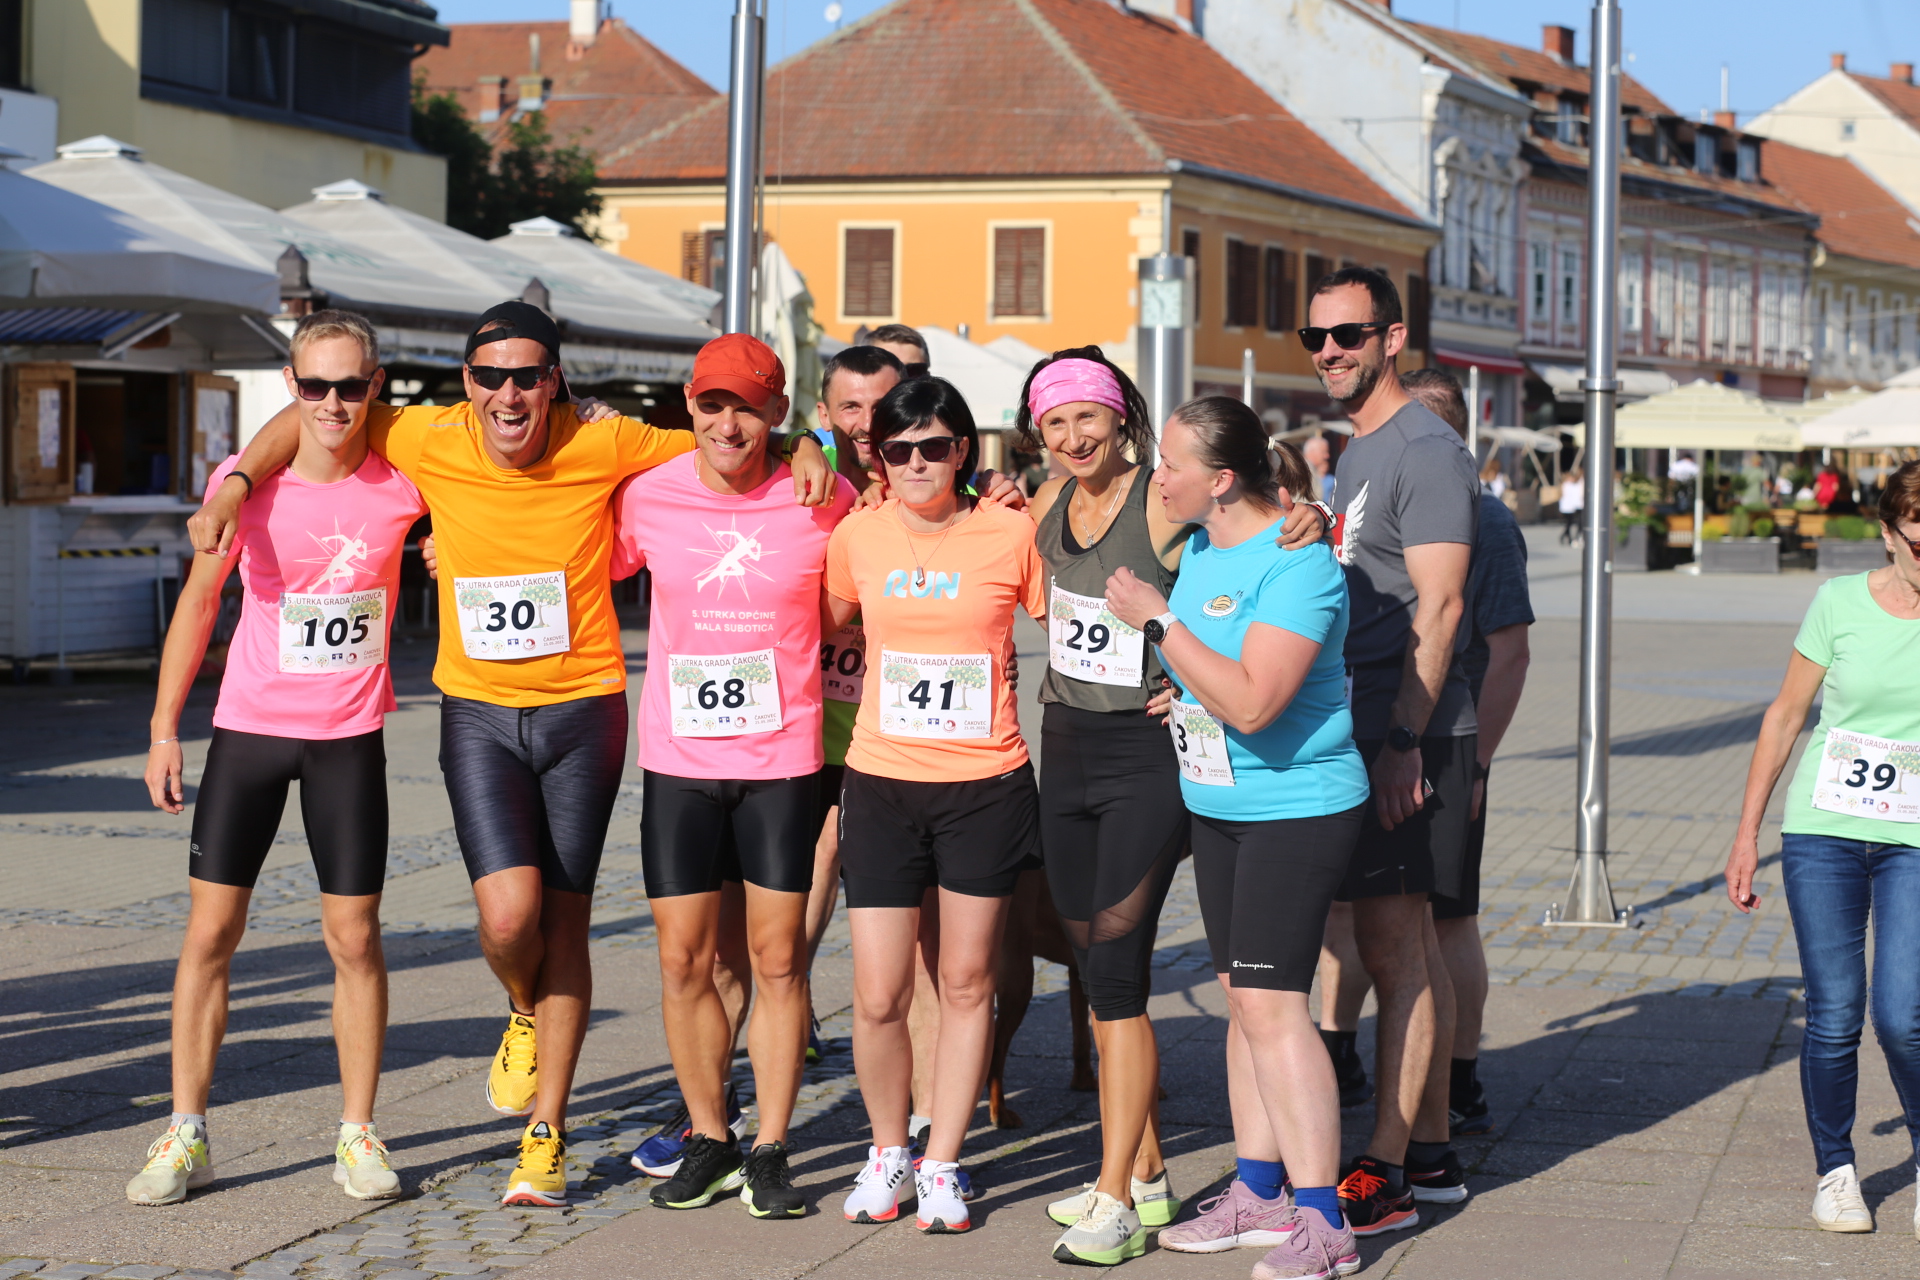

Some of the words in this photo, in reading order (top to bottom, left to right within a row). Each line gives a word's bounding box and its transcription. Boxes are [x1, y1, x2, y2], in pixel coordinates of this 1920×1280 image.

[494, 580, 521, 588] GRADA
[523, 576, 559, 586] ČAKOVCA
[884, 569, 960, 599] RUN
[296, 597, 321, 605] UTRKA
[324, 596, 350, 606] GRADA
[352, 591, 382, 604] ČAKOVCA
[1076, 599, 1100, 610] GRADA
[486, 600, 535, 632] 30
[702, 610, 736, 619] UTRKA
[738, 610, 776, 620] OPĆINE
[304, 614, 370, 647] 105
[695, 623, 721, 631] MALA
[724, 624, 774, 632] SUBOTICA
[1066, 619, 1110, 654] 29
[704, 659, 730, 667] GRADA
[732, 654, 769, 665] ČAKOVCA
[821, 644, 862, 676] 40
[895, 657, 918, 666] UTRKA
[920, 658, 948, 666] GRADA
[950, 656, 986, 667] ČAKOVCA
[698, 678, 745, 710] 68
[908, 679, 954, 710] 41
[1185, 705, 1214, 716] ČAKOVC
[1177, 723, 1188, 753] 3
[1842, 734, 1863, 745] UTRKA
[1864, 738, 1888, 750] GRADA
[1844, 759, 1896, 792] 39
[1232, 960, 1274, 970] Champion
